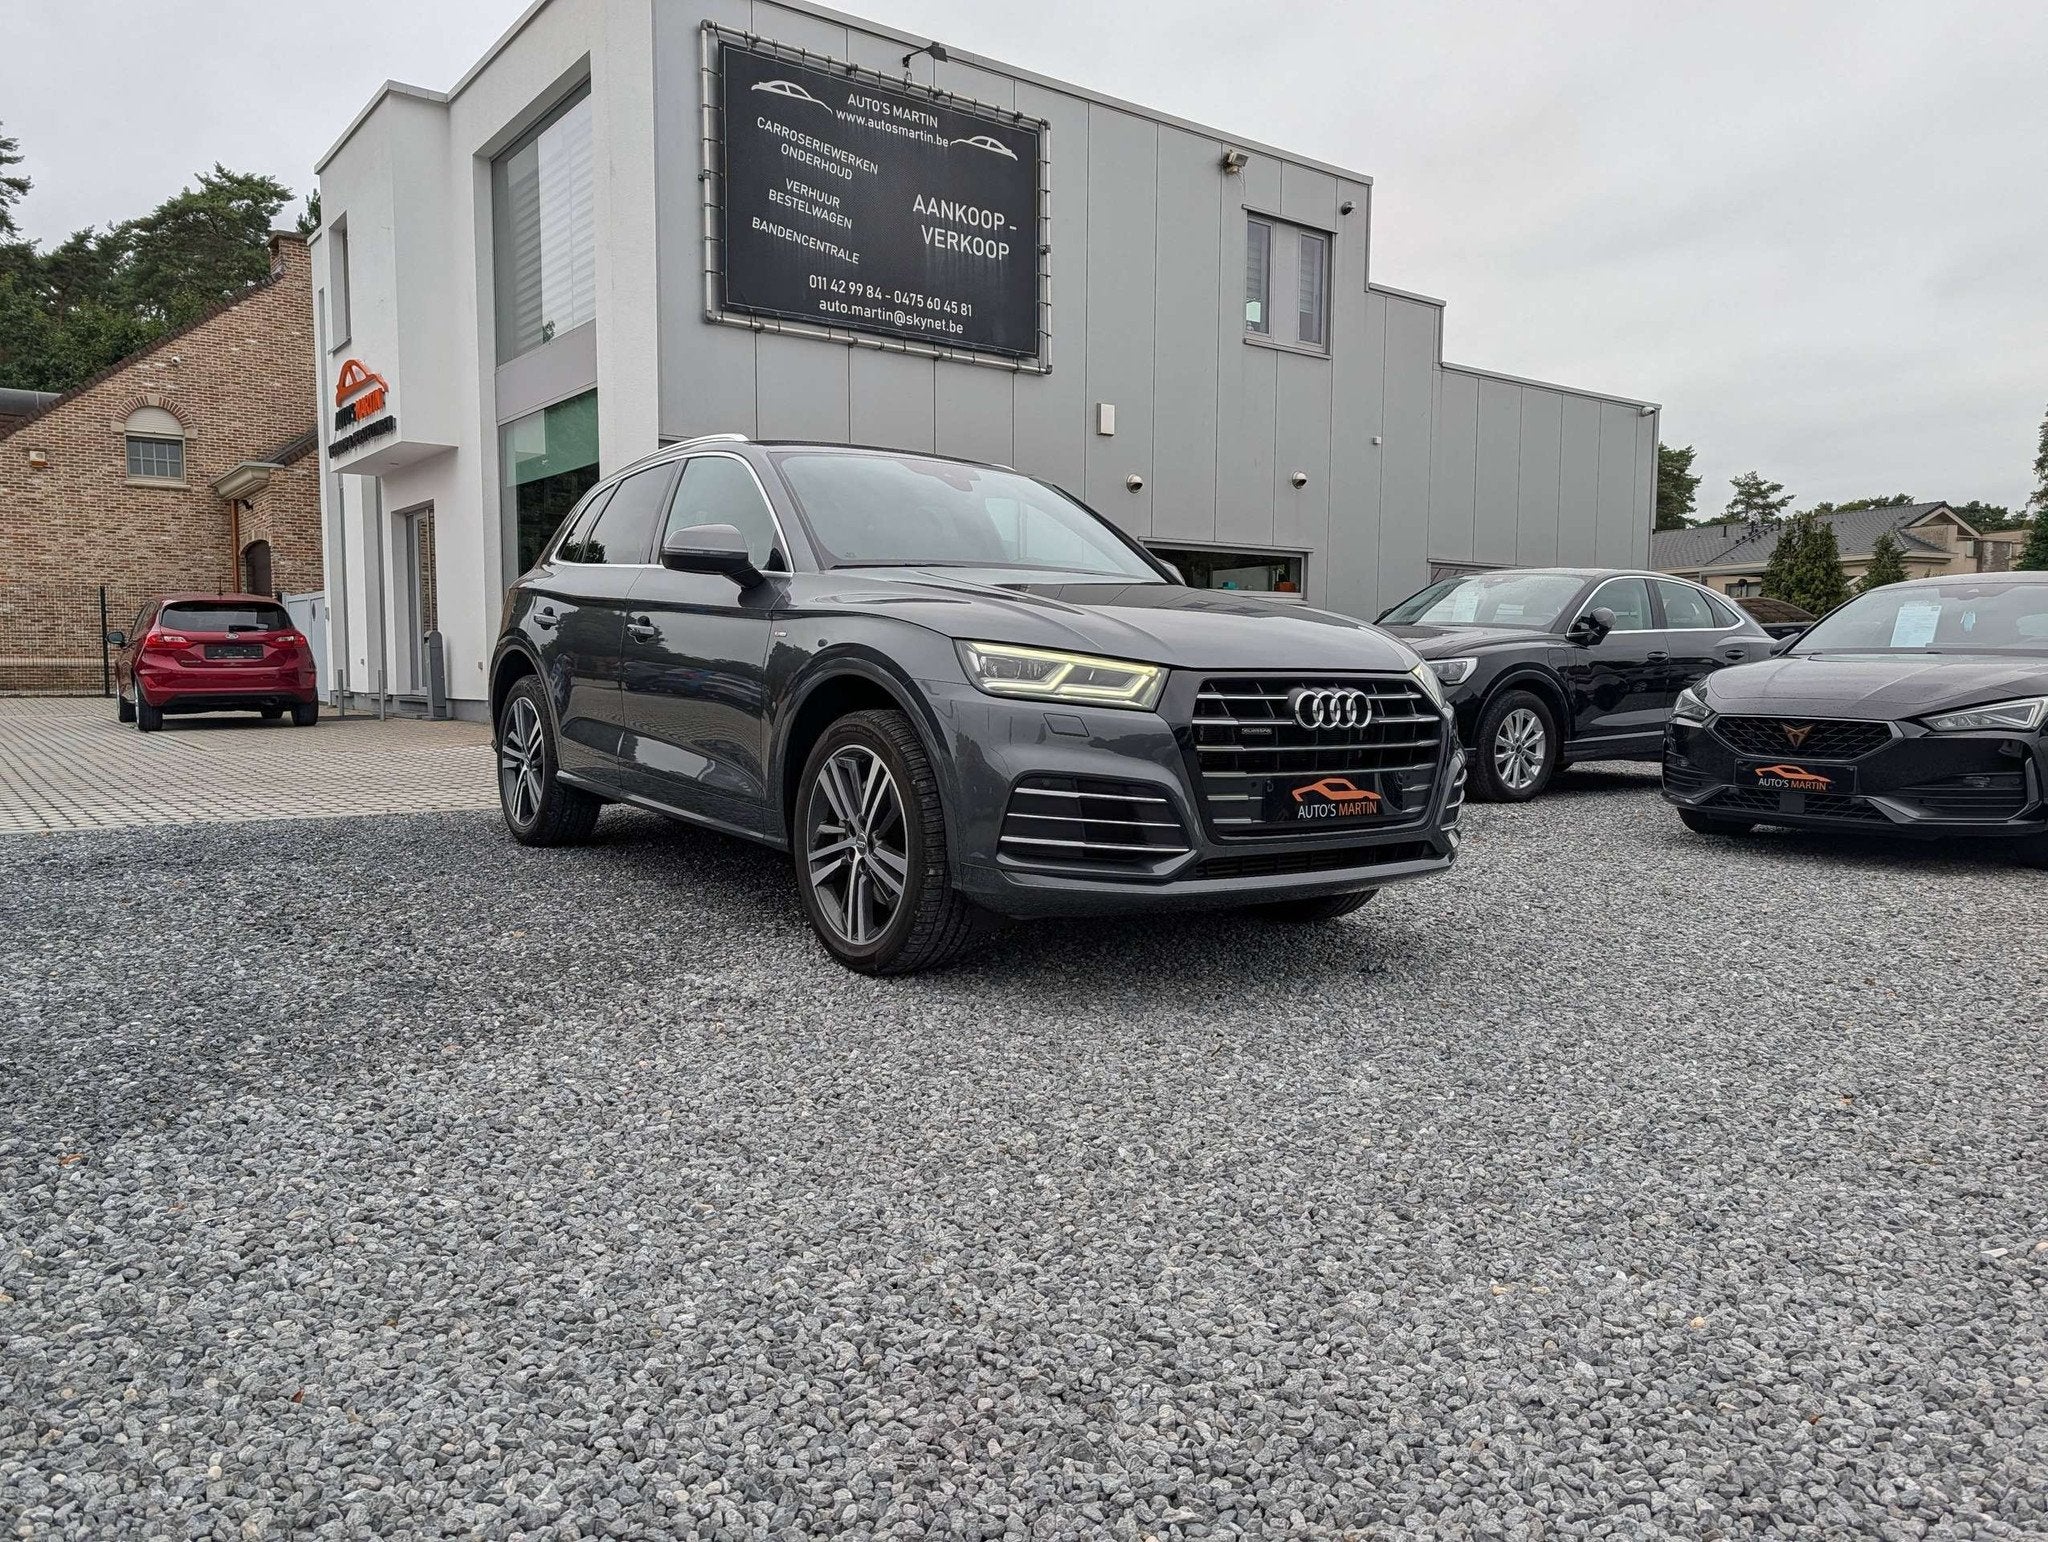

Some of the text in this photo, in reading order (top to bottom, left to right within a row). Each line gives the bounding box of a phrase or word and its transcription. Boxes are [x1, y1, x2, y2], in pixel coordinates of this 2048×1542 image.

[835, 109, 949, 148] www.autosmartin.be
[847, 93, 938, 128] AUTO'S MARTIN
[757, 116, 879, 175] CARROSERIEWERKEN
[781, 143, 853, 180] ONDERHOUD
[768, 188, 853, 230] BESTELWAGEN
[785, 177, 840, 209] VERHUUR
[912, 194, 1005, 231] AANKOOP
[751, 216, 860, 265] BANDENCENTRALE
[921, 224, 1010, 260] VERKOOP
[809, 274, 827, 290] 011
[830, 278, 846, 294] 42
[848, 281, 863, 296] 99
[866, 285, 882, 300] 84
[894, 290, 924, 308] 0475
[926, 296, 941, 311] 60
[943, 300, 958, 316] 45
[960, 303, 973, 317] 81
[818, 299, 964, 334] auto.martin@skynet.be
[1758, 778, 1826, 791] AUTO'S MARTIN
[1297, 801, 1377, 819] AUTO'S MARTIN
